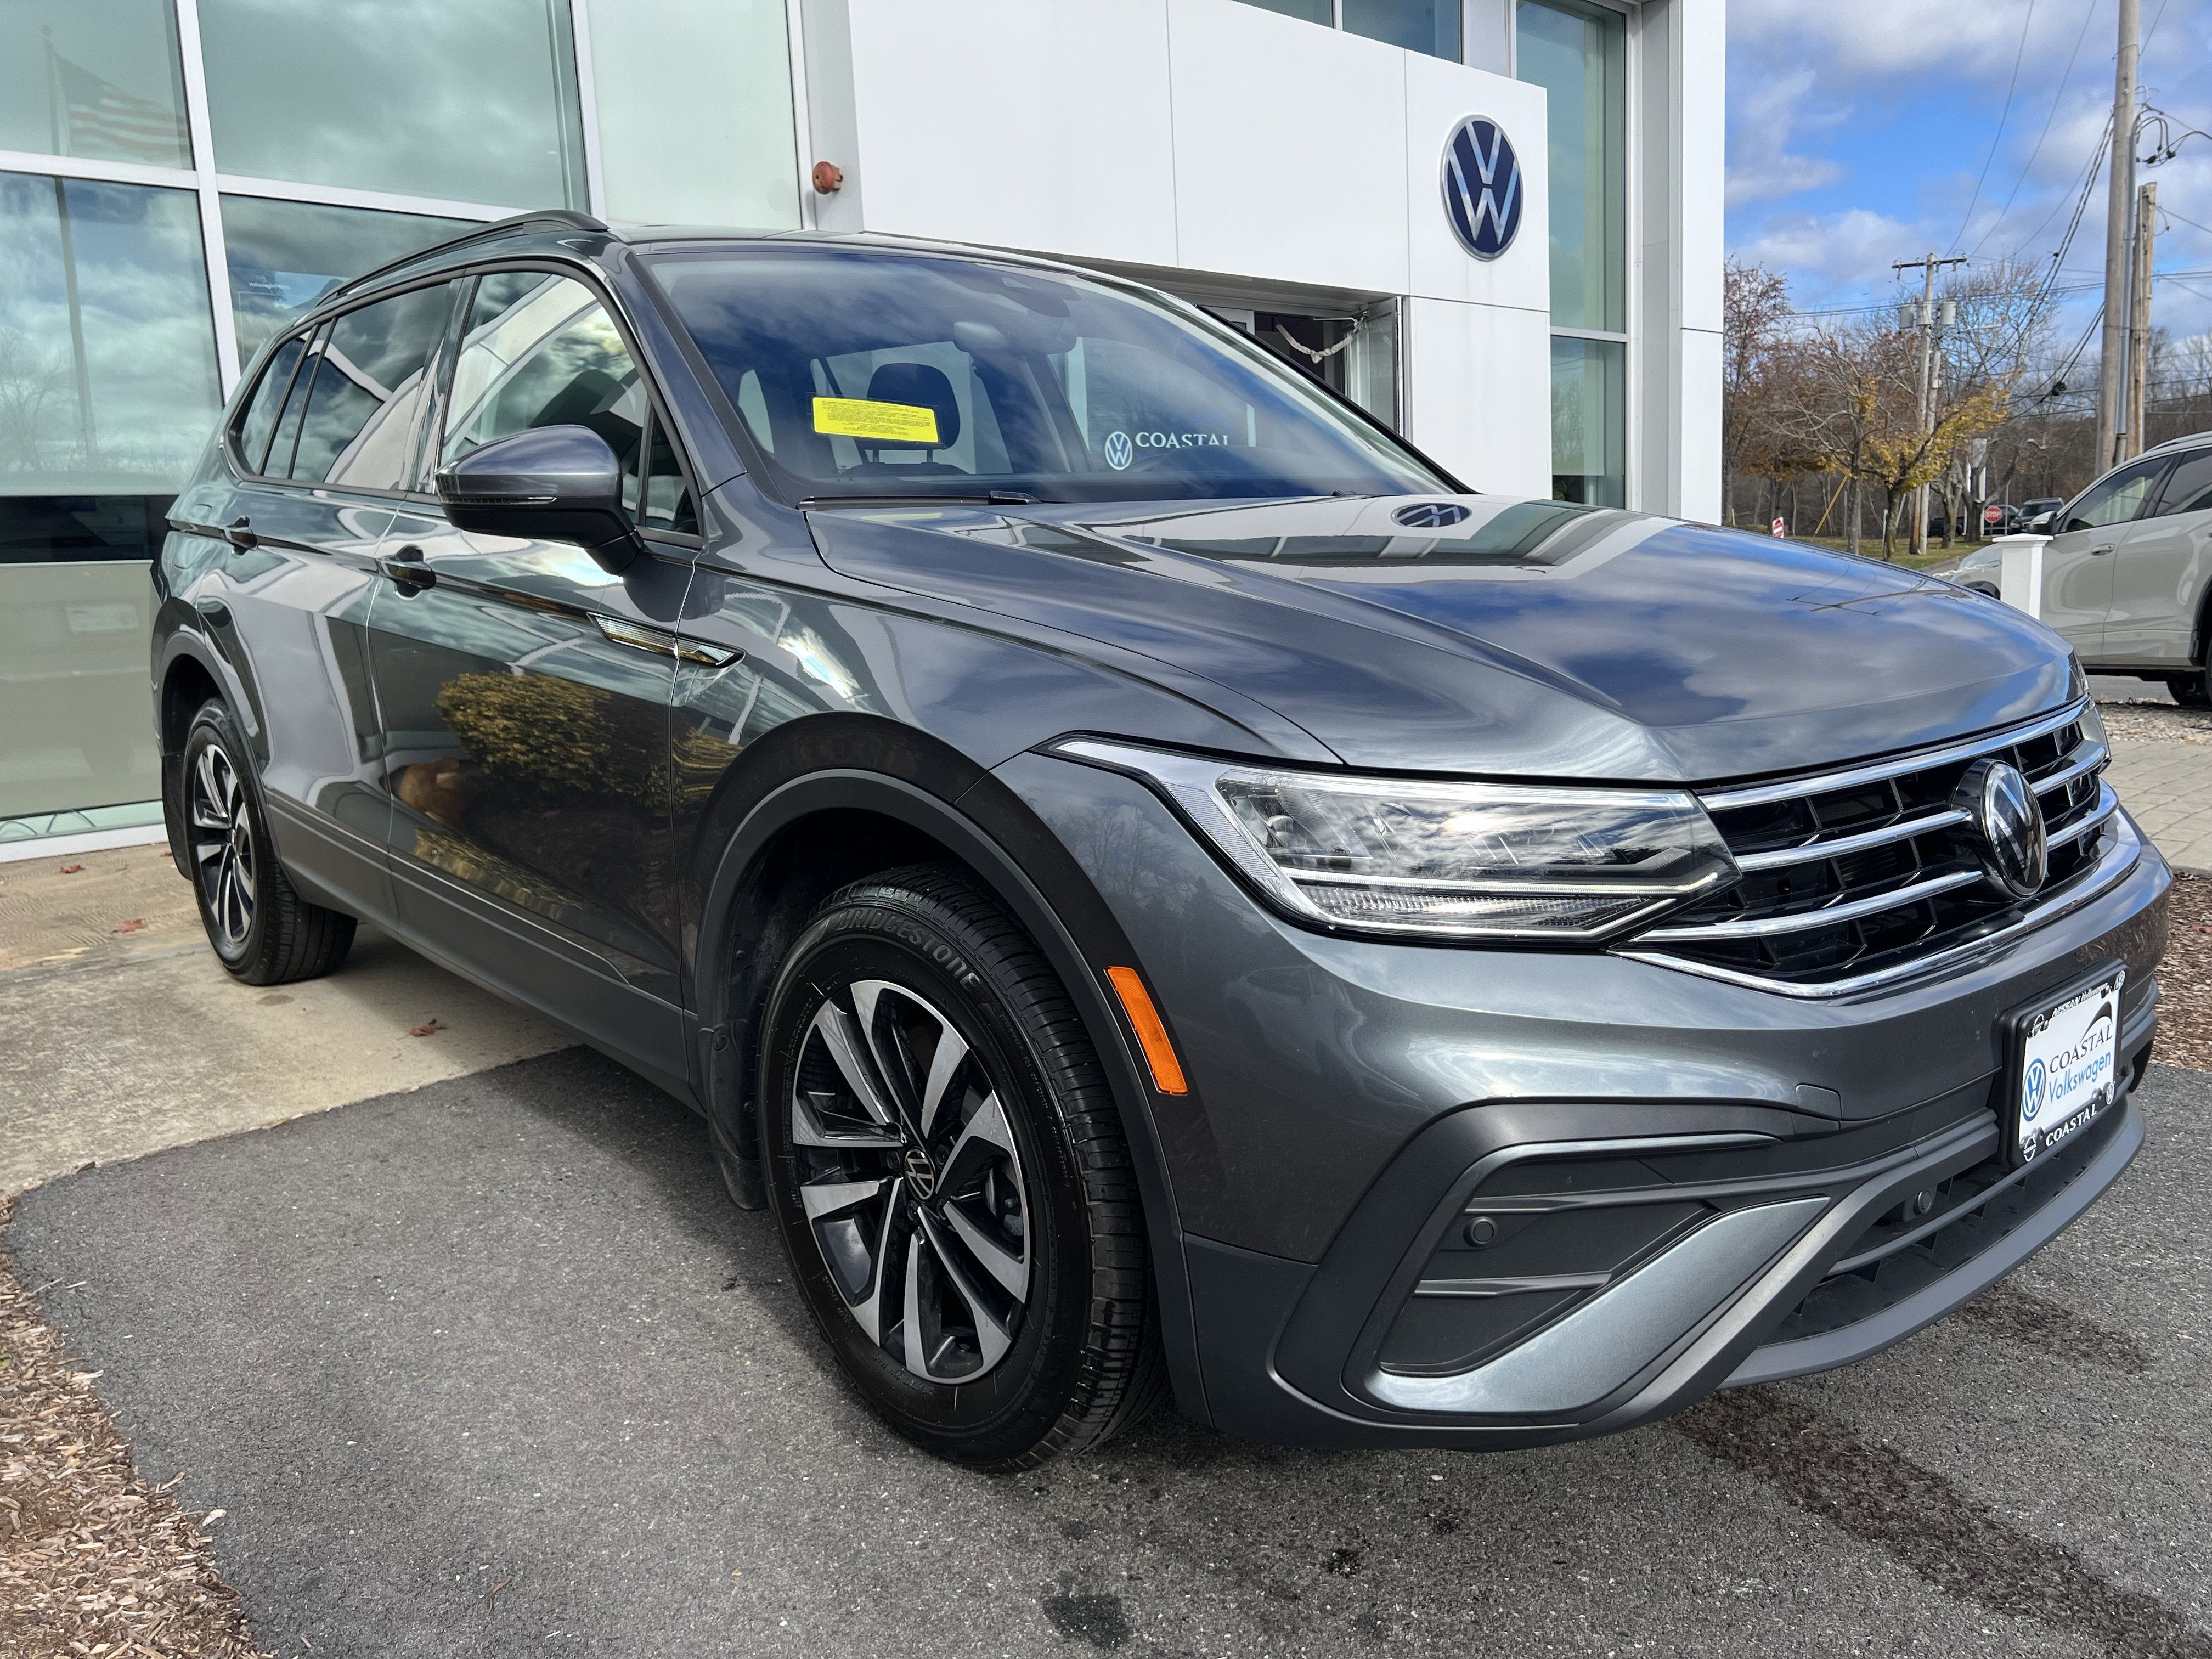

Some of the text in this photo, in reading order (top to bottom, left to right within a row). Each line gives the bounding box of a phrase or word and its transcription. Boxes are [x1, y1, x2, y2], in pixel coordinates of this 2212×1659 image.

[835, 908, 982, 992] BRIDGESTONE
[2050, 1024, 2112, 1073] COASTAL
[2049, 1052, 2111, 1104] Volkswagen
[2045, 1104, 2097, 1147] COASTAL
